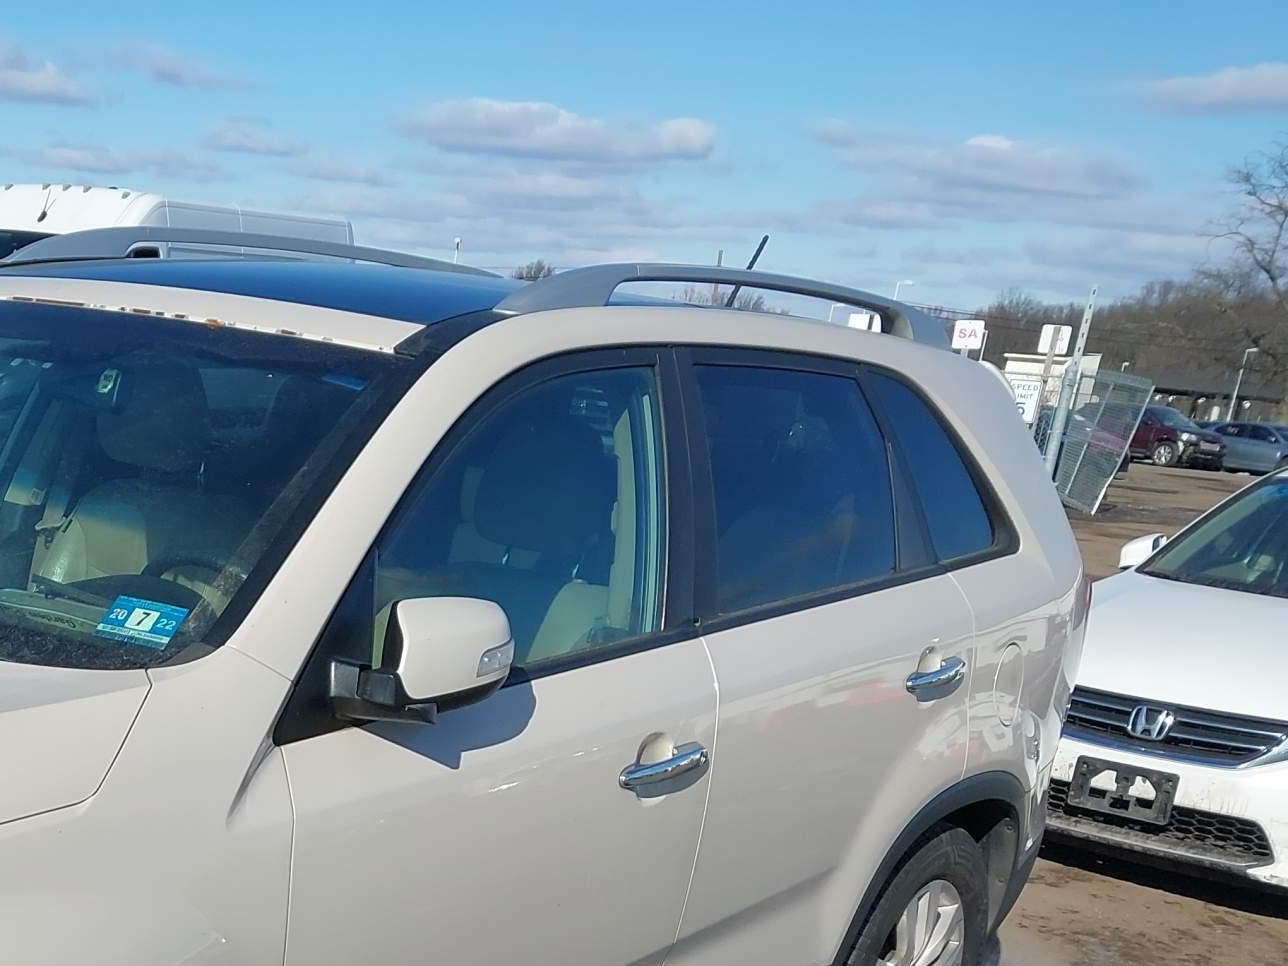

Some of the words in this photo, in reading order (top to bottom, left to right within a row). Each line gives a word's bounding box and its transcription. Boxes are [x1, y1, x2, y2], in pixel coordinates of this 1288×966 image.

[958, 328, 978, 339] SA
[109, 608, 128, 620] 20
[136, 612, 152, 627] 7
[156, 619, 176, 630] 22
